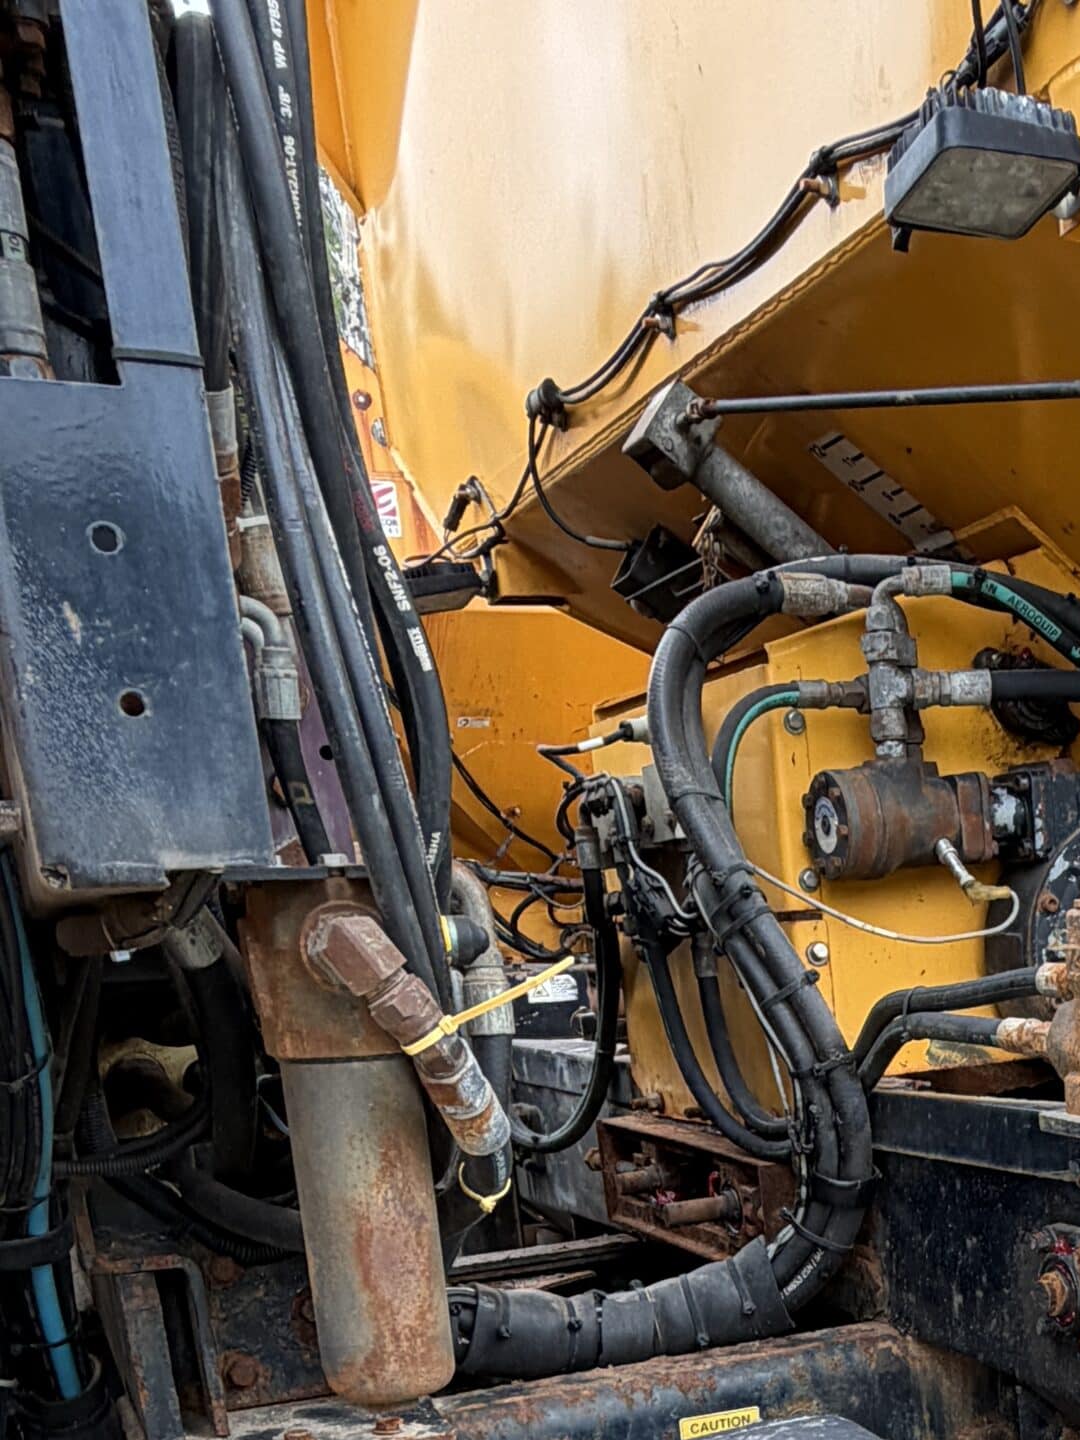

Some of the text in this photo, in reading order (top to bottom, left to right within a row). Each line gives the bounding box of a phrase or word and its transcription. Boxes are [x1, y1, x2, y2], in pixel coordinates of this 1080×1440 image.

[272, 40, 288, 69] WP
[372, 544, 411, 612] SNF2-06
[1007, 594, 1059, 639] AEROQUIP
[690, 1414, 751, 1434] CAUTION
